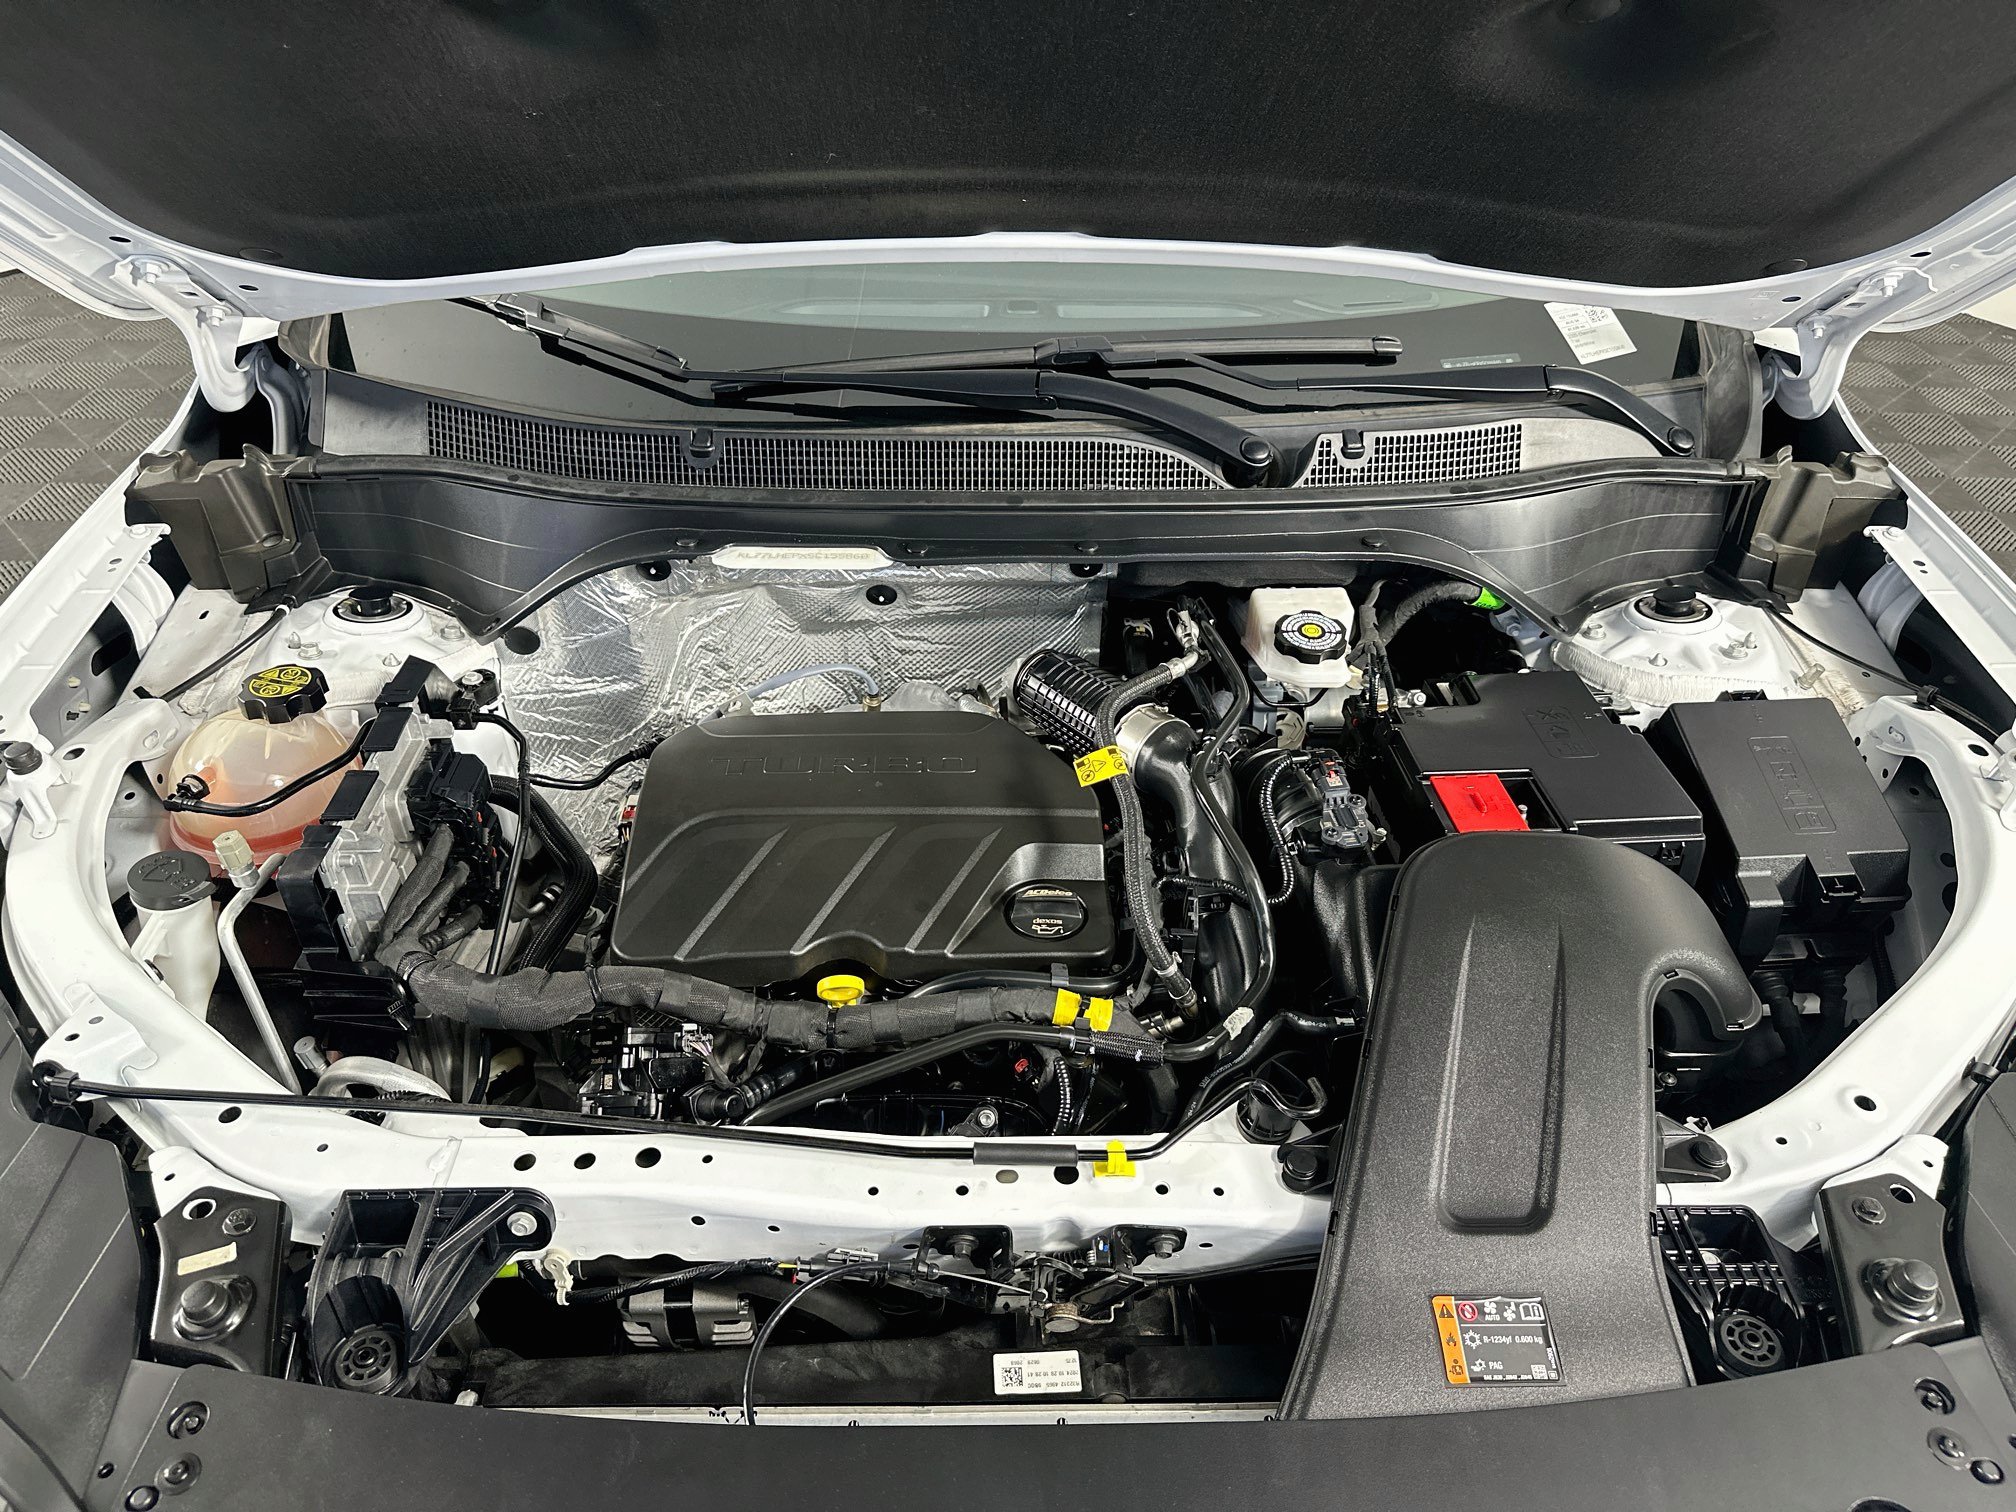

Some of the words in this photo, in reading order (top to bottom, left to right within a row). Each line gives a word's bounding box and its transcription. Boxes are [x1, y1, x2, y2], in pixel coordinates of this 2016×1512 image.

[710, 756, 979, 776] TURBO
[1022, 889, 1073, 898] ACDelco
[1032, 917, 1063, 925] dexos
[1483, 1335, 1513, 1345] R-1234yf
[1534, 1336, 1544, 1345] kg
[1489, 1361, 1503, 1370] PAG
